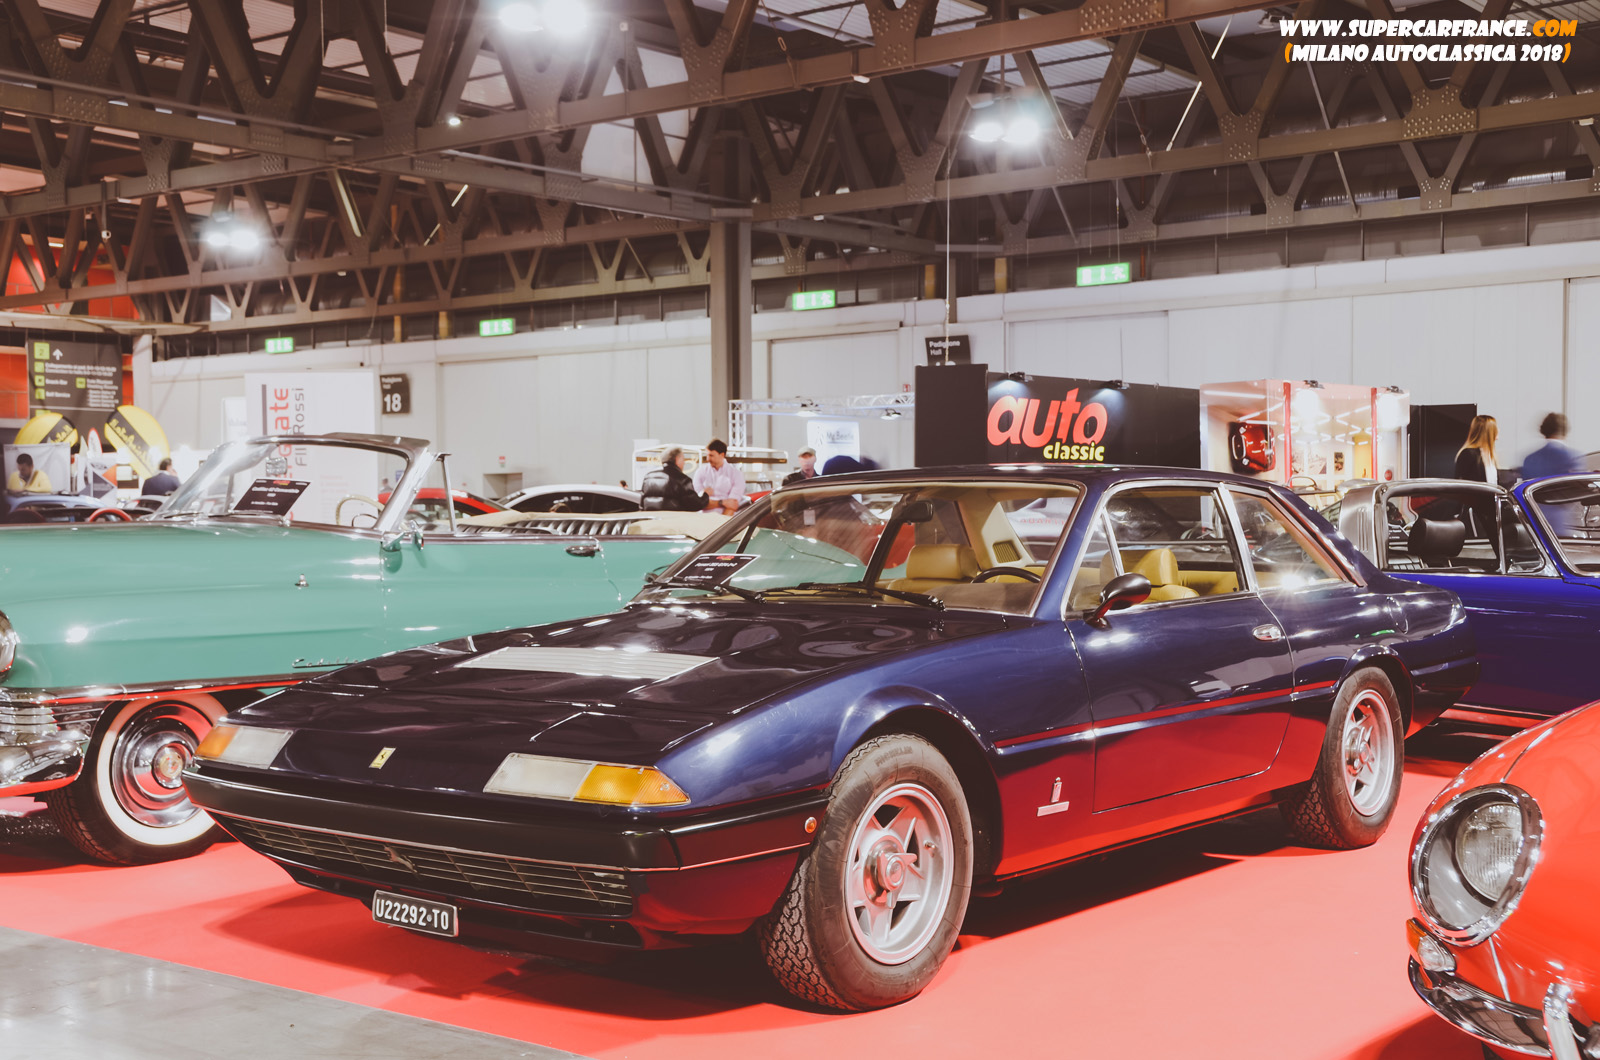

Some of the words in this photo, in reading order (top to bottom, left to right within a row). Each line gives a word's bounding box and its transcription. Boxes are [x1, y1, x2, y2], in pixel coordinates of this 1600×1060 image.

[384, 393, 402, 412] 18
[987, 387, 1108, 448] auto
[1043, 441, 1105, 461] classic
